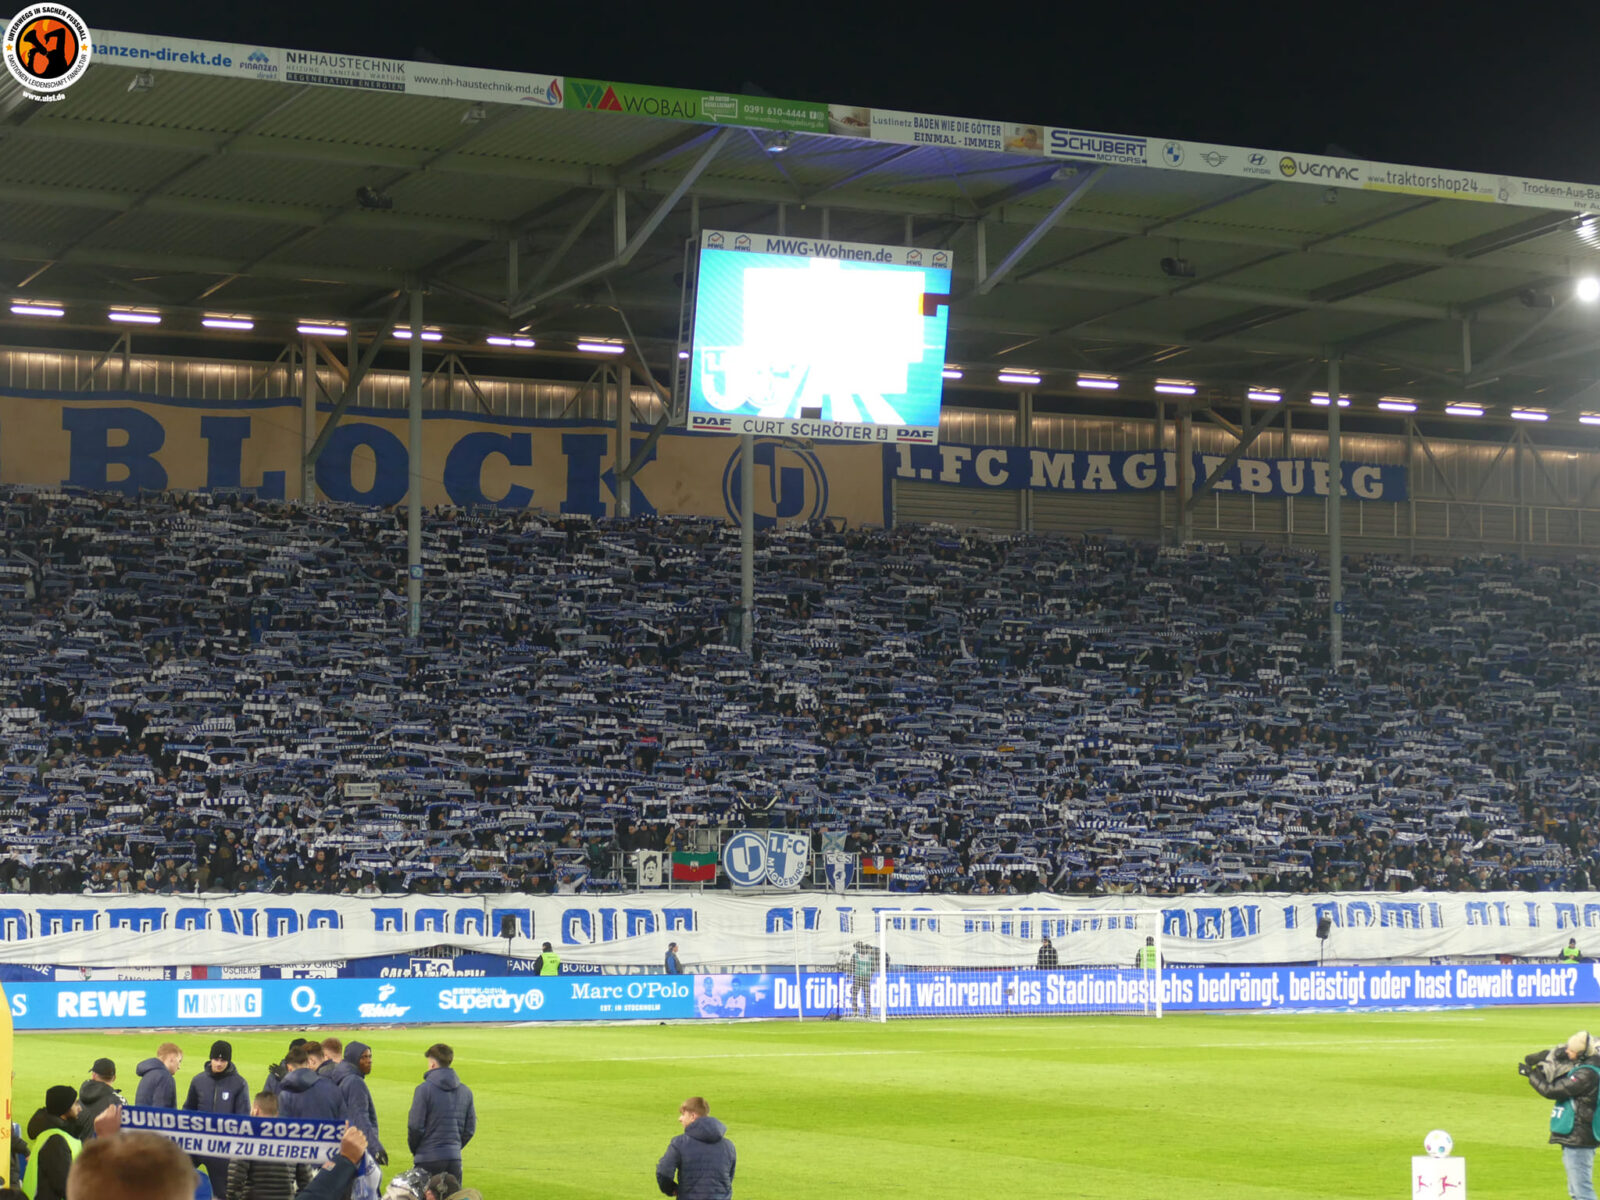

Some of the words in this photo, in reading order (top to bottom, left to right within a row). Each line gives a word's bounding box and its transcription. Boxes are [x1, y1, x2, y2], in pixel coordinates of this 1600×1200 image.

[91, 44, 232, 67] nanzen-direkt.de
[414, 74, 545, 96] www.nh-haustechnik-md.de
[624, 95, 696, 118] WOBAU
[744, 105, 764, 114] 0391
[914, 117, 940, 130] BADEN
[941, 120, 955, 132] WIE
[957, 121, 969, 133] DIE
[914, 132, 956, 145] EINMAL
[964, 137, 1001, 149] IMMER
[1051, 129, 1147, 156] SCHUBERT
[1096, 154, 1142, 164] MOTORS
[766, 238, 892, 262] MWG-Wohnen.de
[692, 416, 732, 426] DAF
[743, 419, 785, 434] CURT
[790, 422, 871, 440] SCHRÖTER
[896, 429, 934, 438] DAF
[766, 857, 804, 886] MAGDEBURG
[571, 983, 623, 999] Marc
[775, 978, 798, 1010] Du
[870, 976, 911, 1008] dch
[917, 976, 1002, 1009] während
[1012, 975, 1041, 1007] des
[1047, 973, 1193, 1005] Stadionbesuchs
[1198, 972, 1284, 1006] bedrängt,
[1290, 970, 1366, 1005] belästigt
[1370, 970, 1411, 1000] oder
[1415, 969, 1452, 999] hast
[1456, 968, 1514, 999] Gewalt
[1517, 967, 1578, 998] erlebt?
[58, 990, 147, 1017] REWE
[184, 994, 257, 1014] MUSTANG
[121, 1110, 254, 1136] BUNDESLIGA
[260, 1122, 345, 1141] 2022/23
[207, 1139, 231, 1154] UM
[235, 1142, 254, 1156] ZU
[259, 1144, 319, 1159] BLEIBEN
